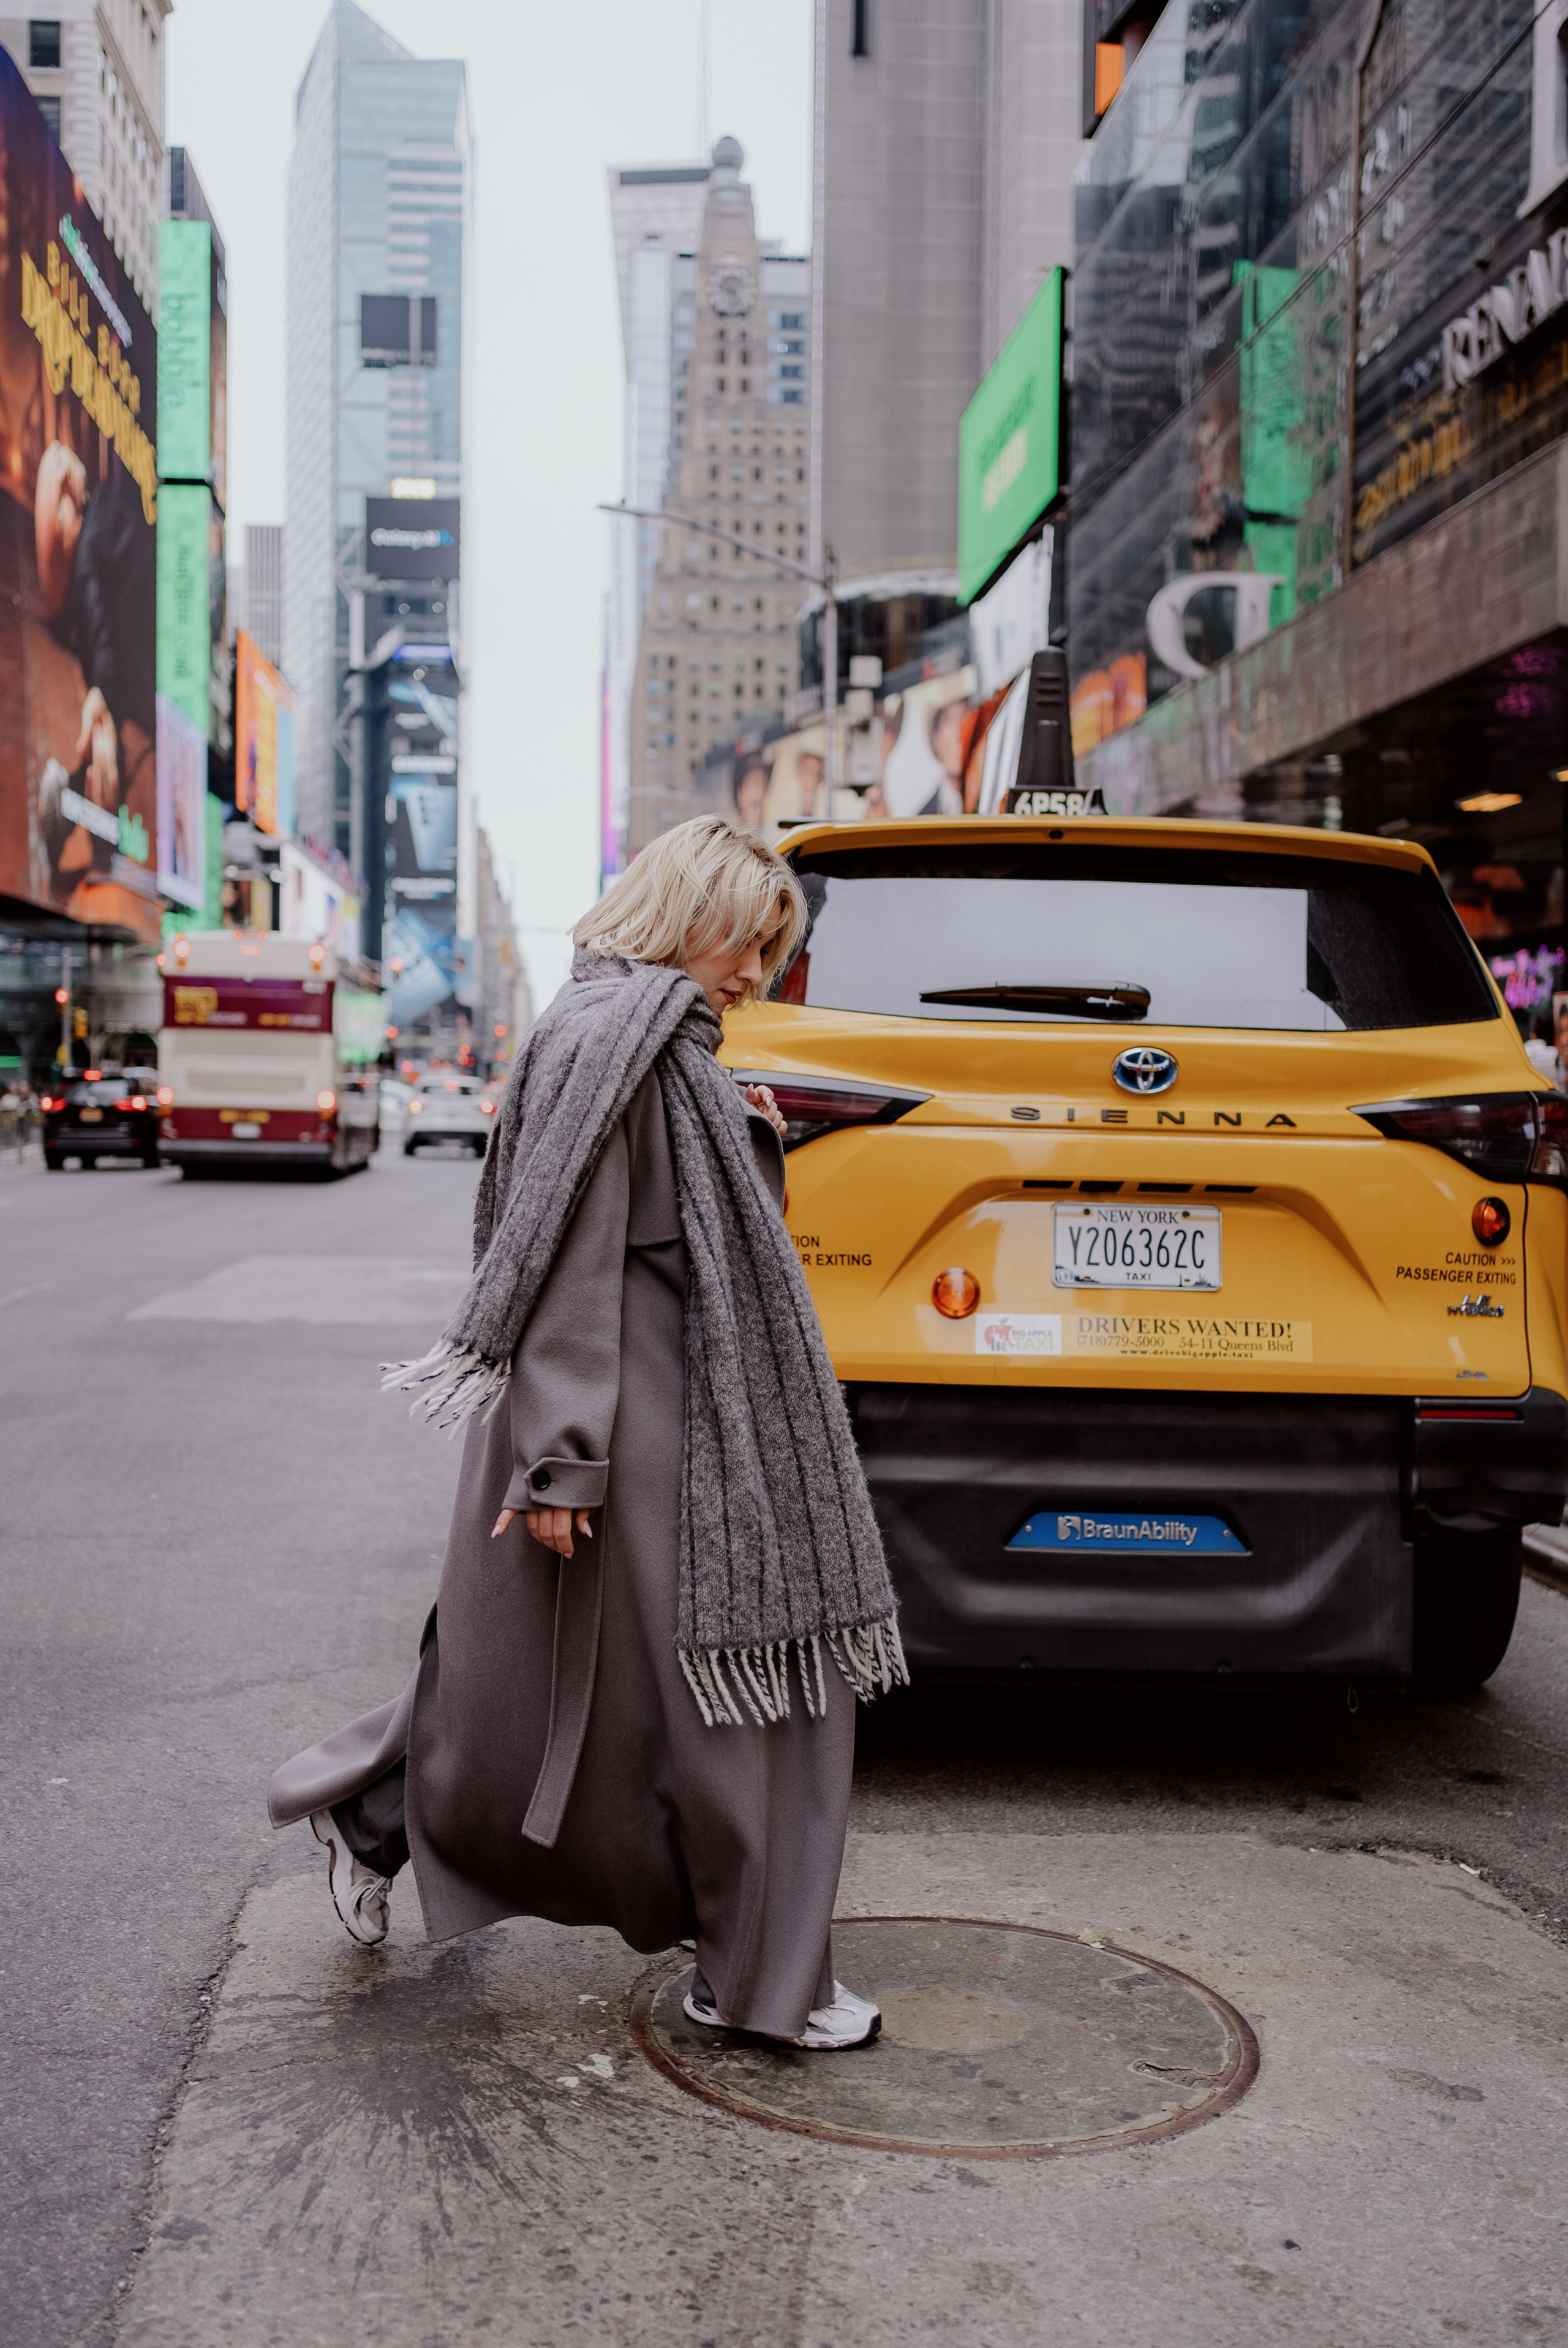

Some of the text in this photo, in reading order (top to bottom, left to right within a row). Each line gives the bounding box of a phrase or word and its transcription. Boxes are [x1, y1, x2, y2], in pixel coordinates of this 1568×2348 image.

[47, 240, 91, 338] BILL
[1014, 791, 1084, 816] 6P58
[1011, 1106, 1297, 1127] SIENNA
[1096, 1209, 1178, 1224] NEW YORK
[1069, 1226, 1205, 1269] Y206362C
[816, 1253, 872, 1266] EXITING
[1446, 1251, 1496, 1266] CAUTION
[1125, 1272, 1152, 1281] TAXI
[1396, 1266, 1516, 1285] PASSENGER EXITING
[1078, 1317, 1292, 1338] DRIVERS WANTED!
[1013, 1337, 1053, 1351] TAXI
[1077, 1335, 1294, 1353] (718)779-5000 54-11 Queens Blvd
[1120, 1349, 1253, 1358] www.drivebigapple.taxi
[1083, 1519, 1199, 1547] BraunAbility
